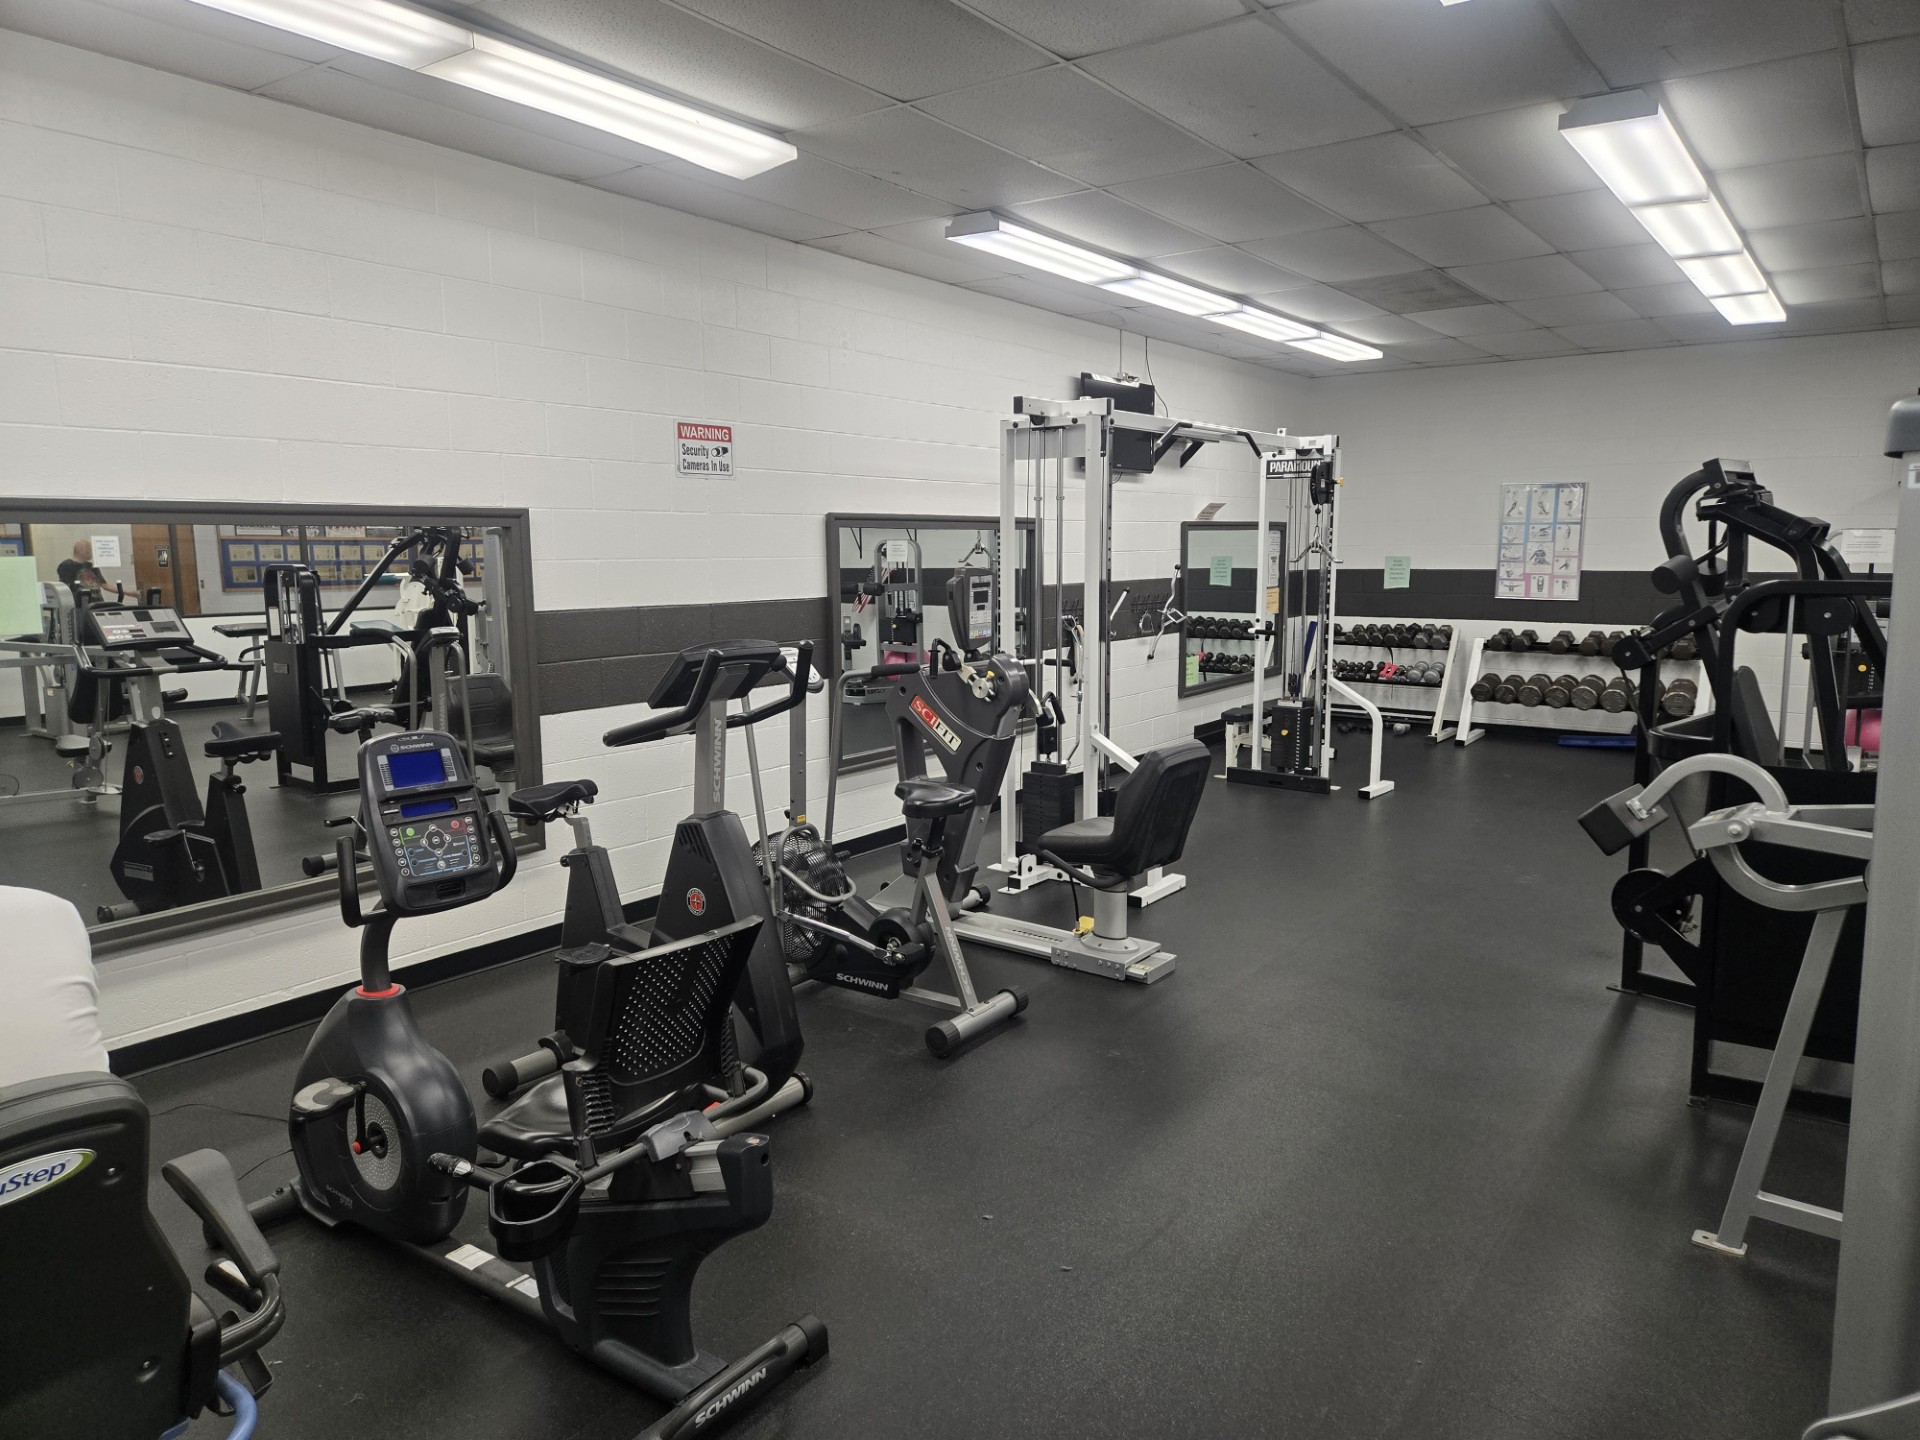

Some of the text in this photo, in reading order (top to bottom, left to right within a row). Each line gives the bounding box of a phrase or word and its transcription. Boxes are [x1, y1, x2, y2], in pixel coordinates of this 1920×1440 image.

[680, 425, 729, 441] WARNING
[682, 443, 709, 459] Security
[682, 458, 730, 472] Cameras In Use
[1270, 460, 1320, 473] PARAMOUN
[914, 700, 958, 744] SCIFIT
[713, 718, 722, 803] SCHWINN
[945, 926, 971, 995] SCHWINN
[836, 972, 889, 992] SCHWINN
[695, 1367, 767, 1429] SCHWINN
